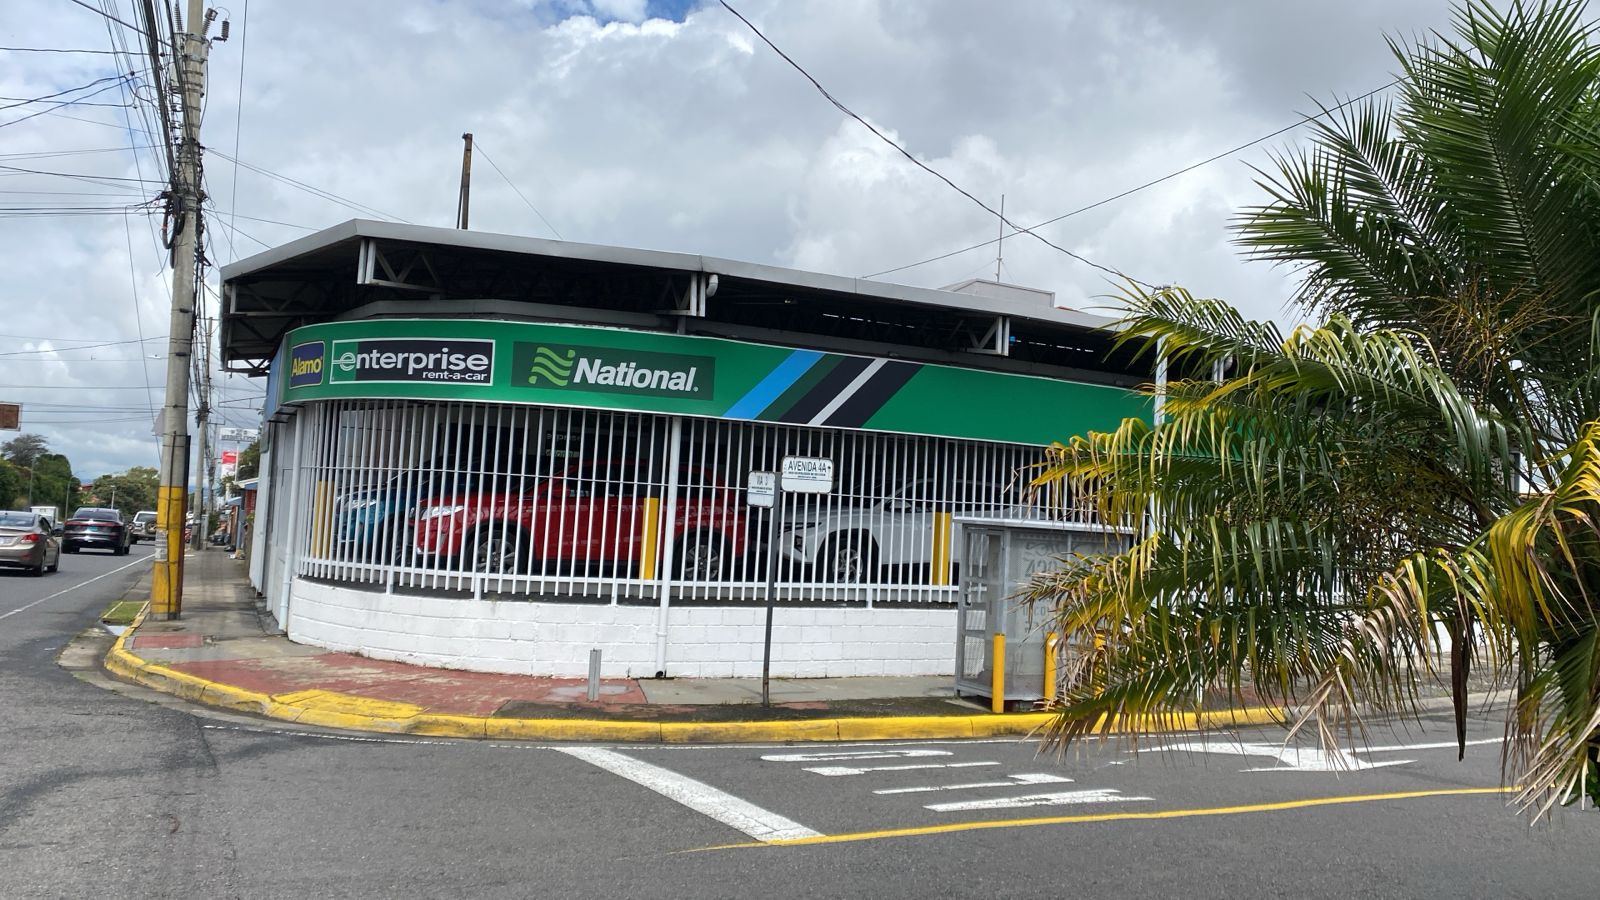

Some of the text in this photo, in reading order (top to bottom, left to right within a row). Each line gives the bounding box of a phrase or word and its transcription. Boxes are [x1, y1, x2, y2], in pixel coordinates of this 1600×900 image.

[291, 358, 322, 377] Alamo
[337, 347, 489, 375] enterprise
[422, 370, 488, 381] rent-a-car
[788, 460, 827, 473] AVENIDA 4A
